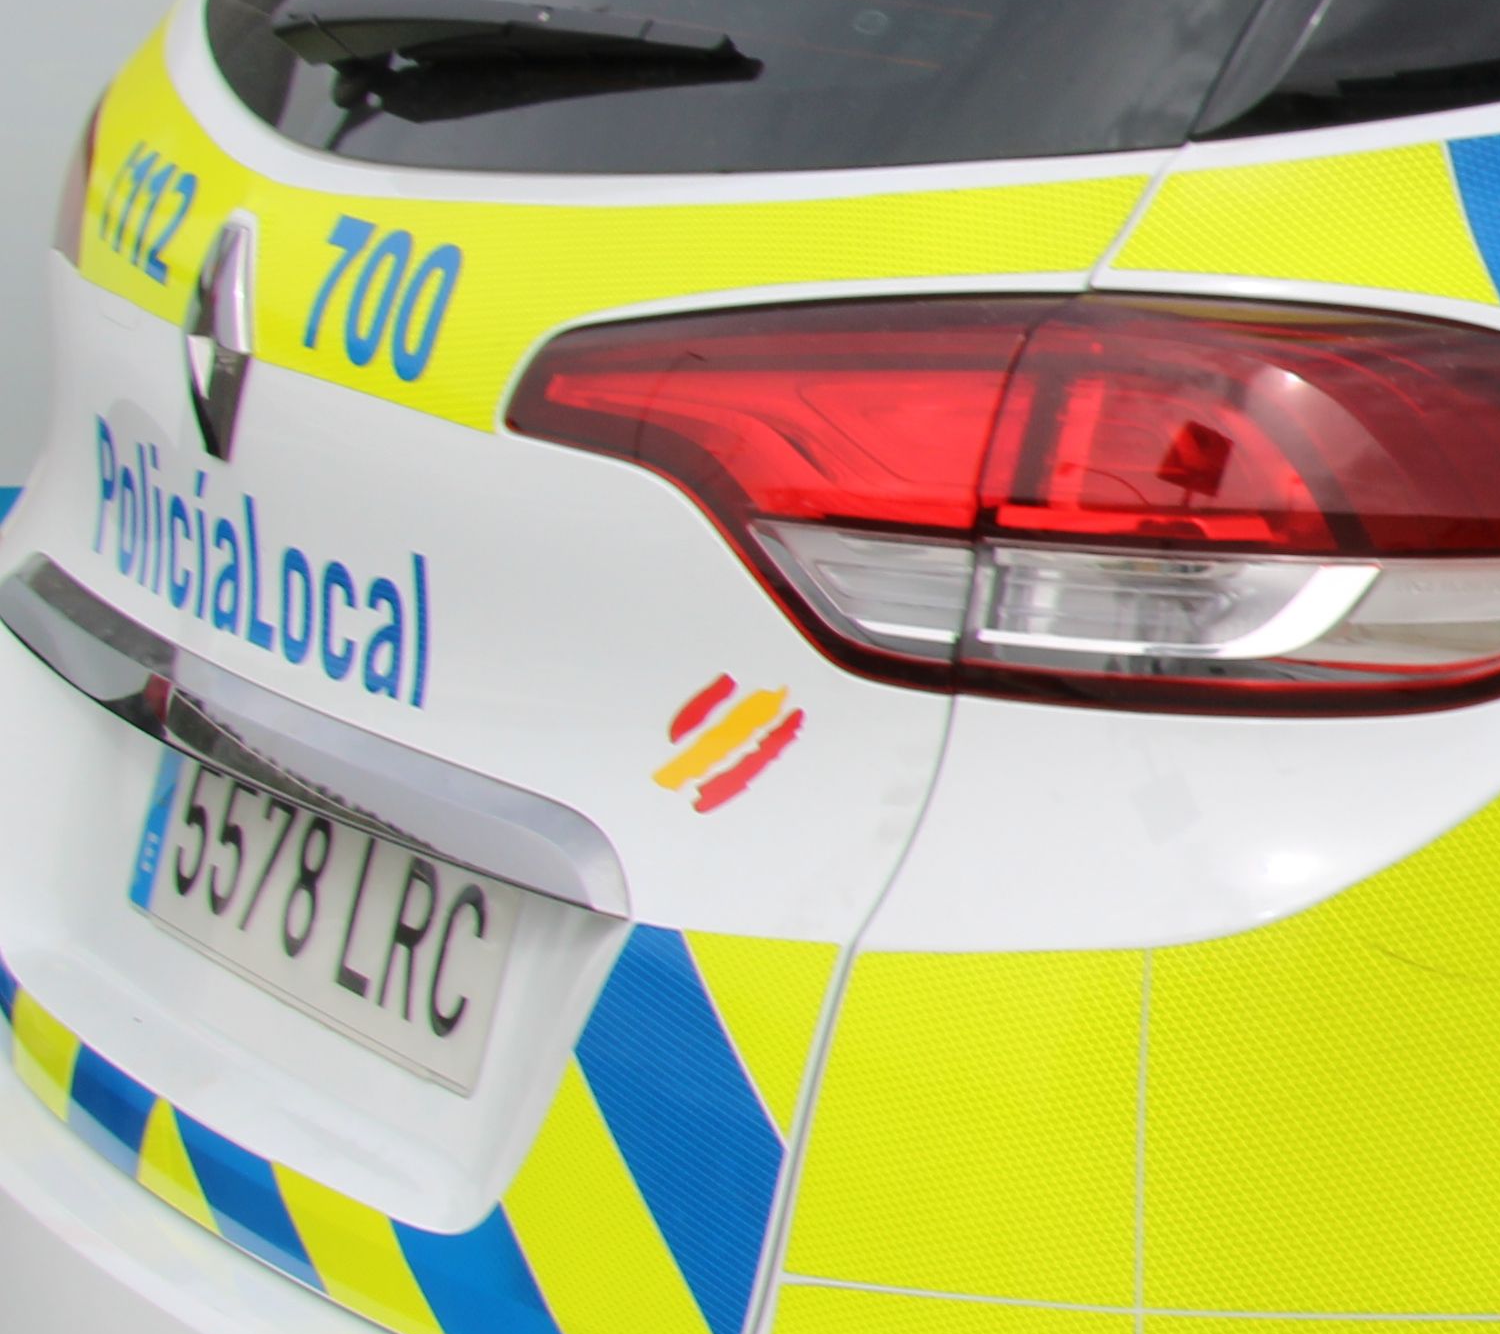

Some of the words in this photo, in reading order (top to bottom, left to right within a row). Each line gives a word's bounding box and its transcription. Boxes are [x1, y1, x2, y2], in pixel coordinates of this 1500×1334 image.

[114, 151, 197, 286] 112
[304, 213, 463, 381] 700
[173, 763, 334, 958] 5578
[335, 835, 487, 1037] LRC
